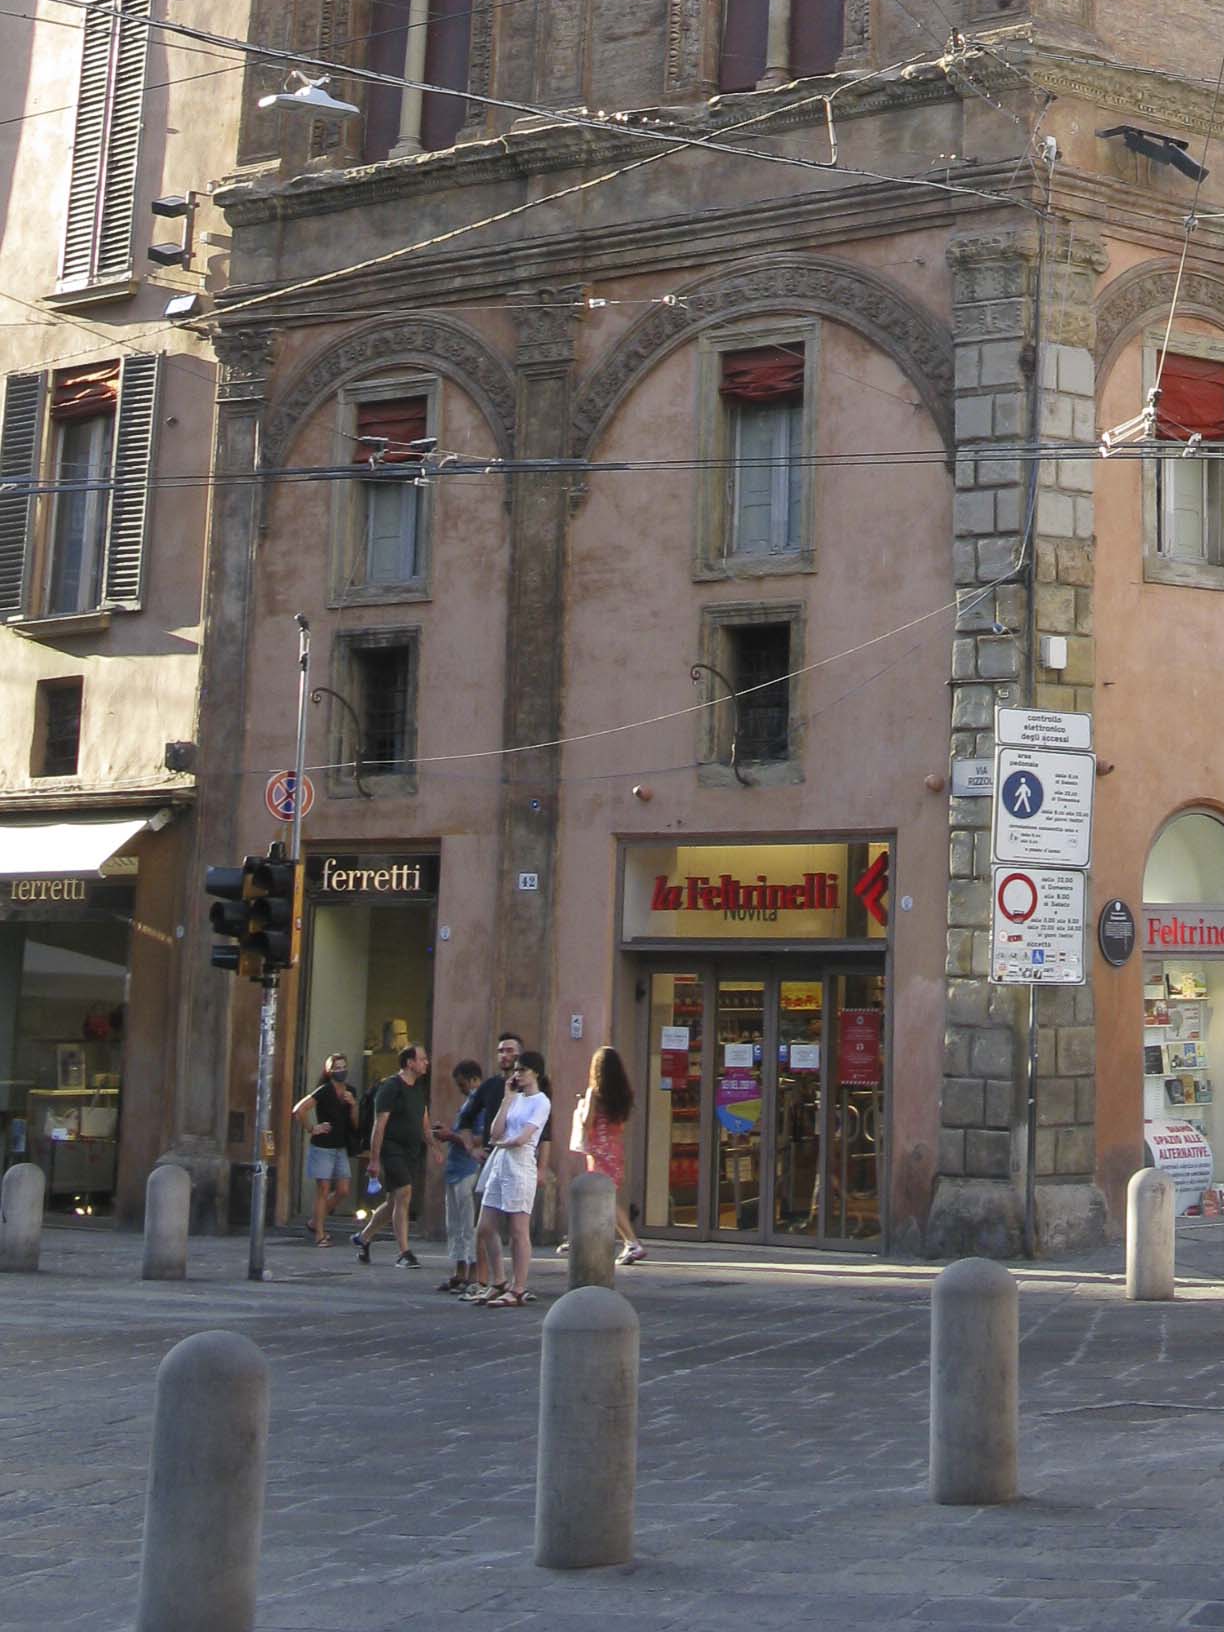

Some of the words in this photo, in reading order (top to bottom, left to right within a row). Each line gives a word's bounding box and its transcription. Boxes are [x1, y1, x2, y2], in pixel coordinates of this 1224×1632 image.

[975, 765, 988, 776] VIA
[321, 857, 422, 892] ferretti
[520, 874, 537, 888] 42
[651, 874, 684, 912] la
[684, 872, 841, 912] Feltrinelli
[1153, 1135, 1183, 1145] SPAZIO
